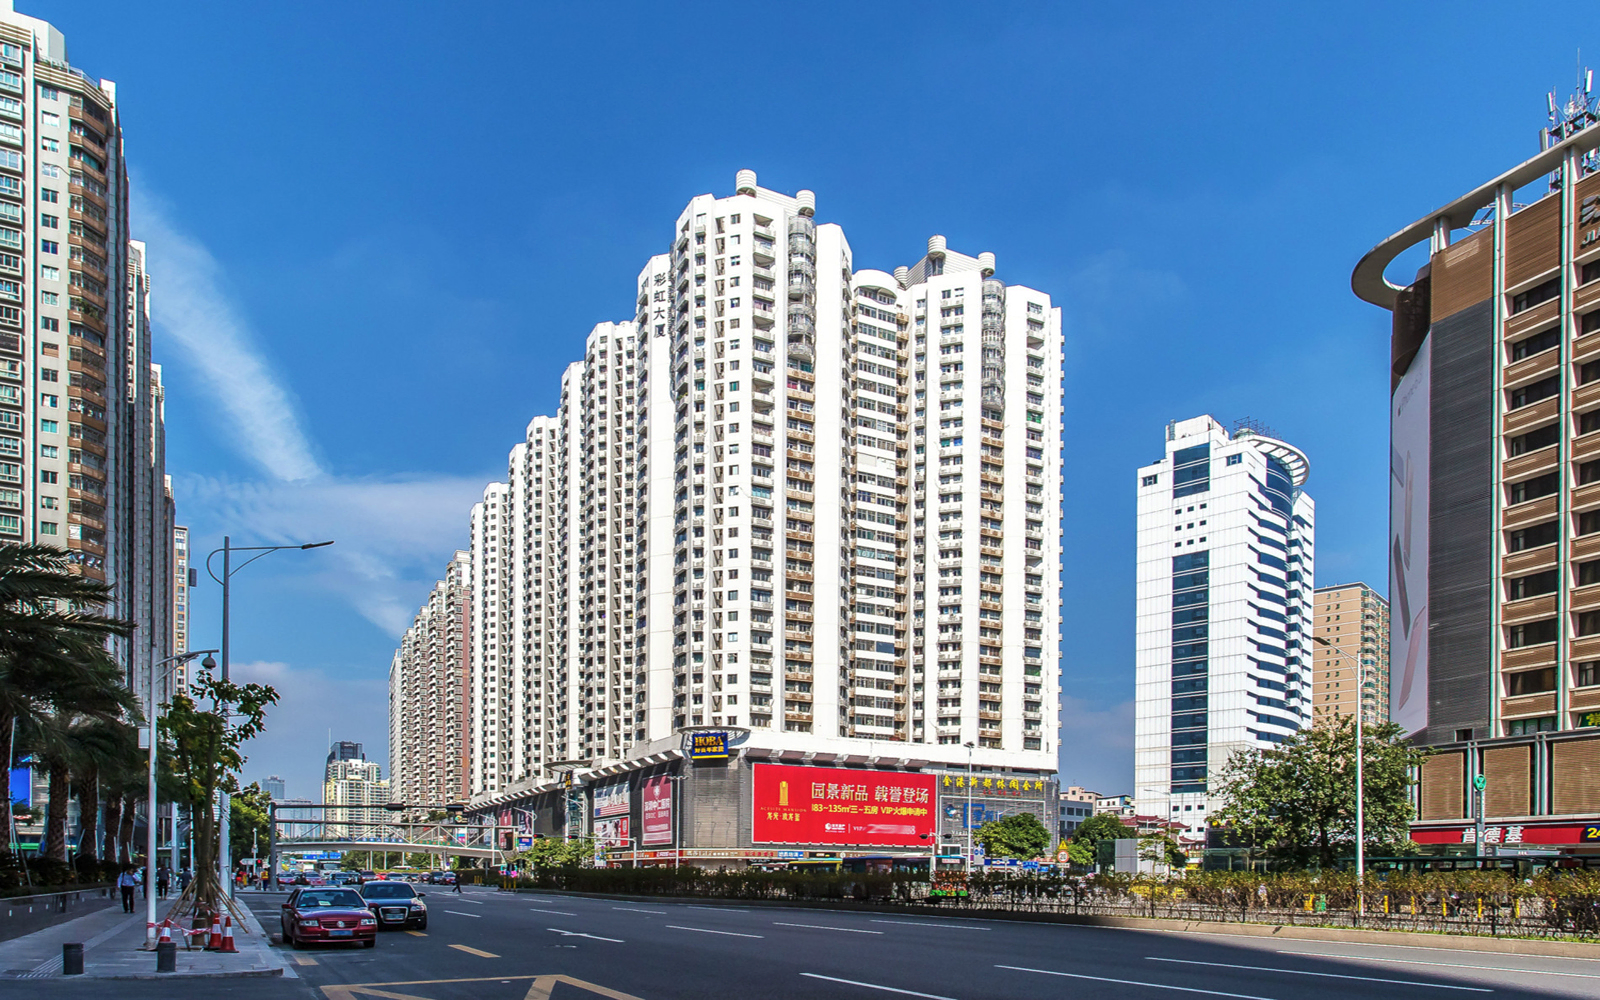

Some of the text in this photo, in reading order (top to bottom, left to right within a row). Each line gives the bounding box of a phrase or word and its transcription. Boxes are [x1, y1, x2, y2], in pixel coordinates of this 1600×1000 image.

[653, 272, 667, 338] 彩虹大厦
[694, 736, 724, 746] HOBA
[811, 782, 929, 804] 园景新品 载誉登场
[1462, 826, 1524, 843] 肯德基
